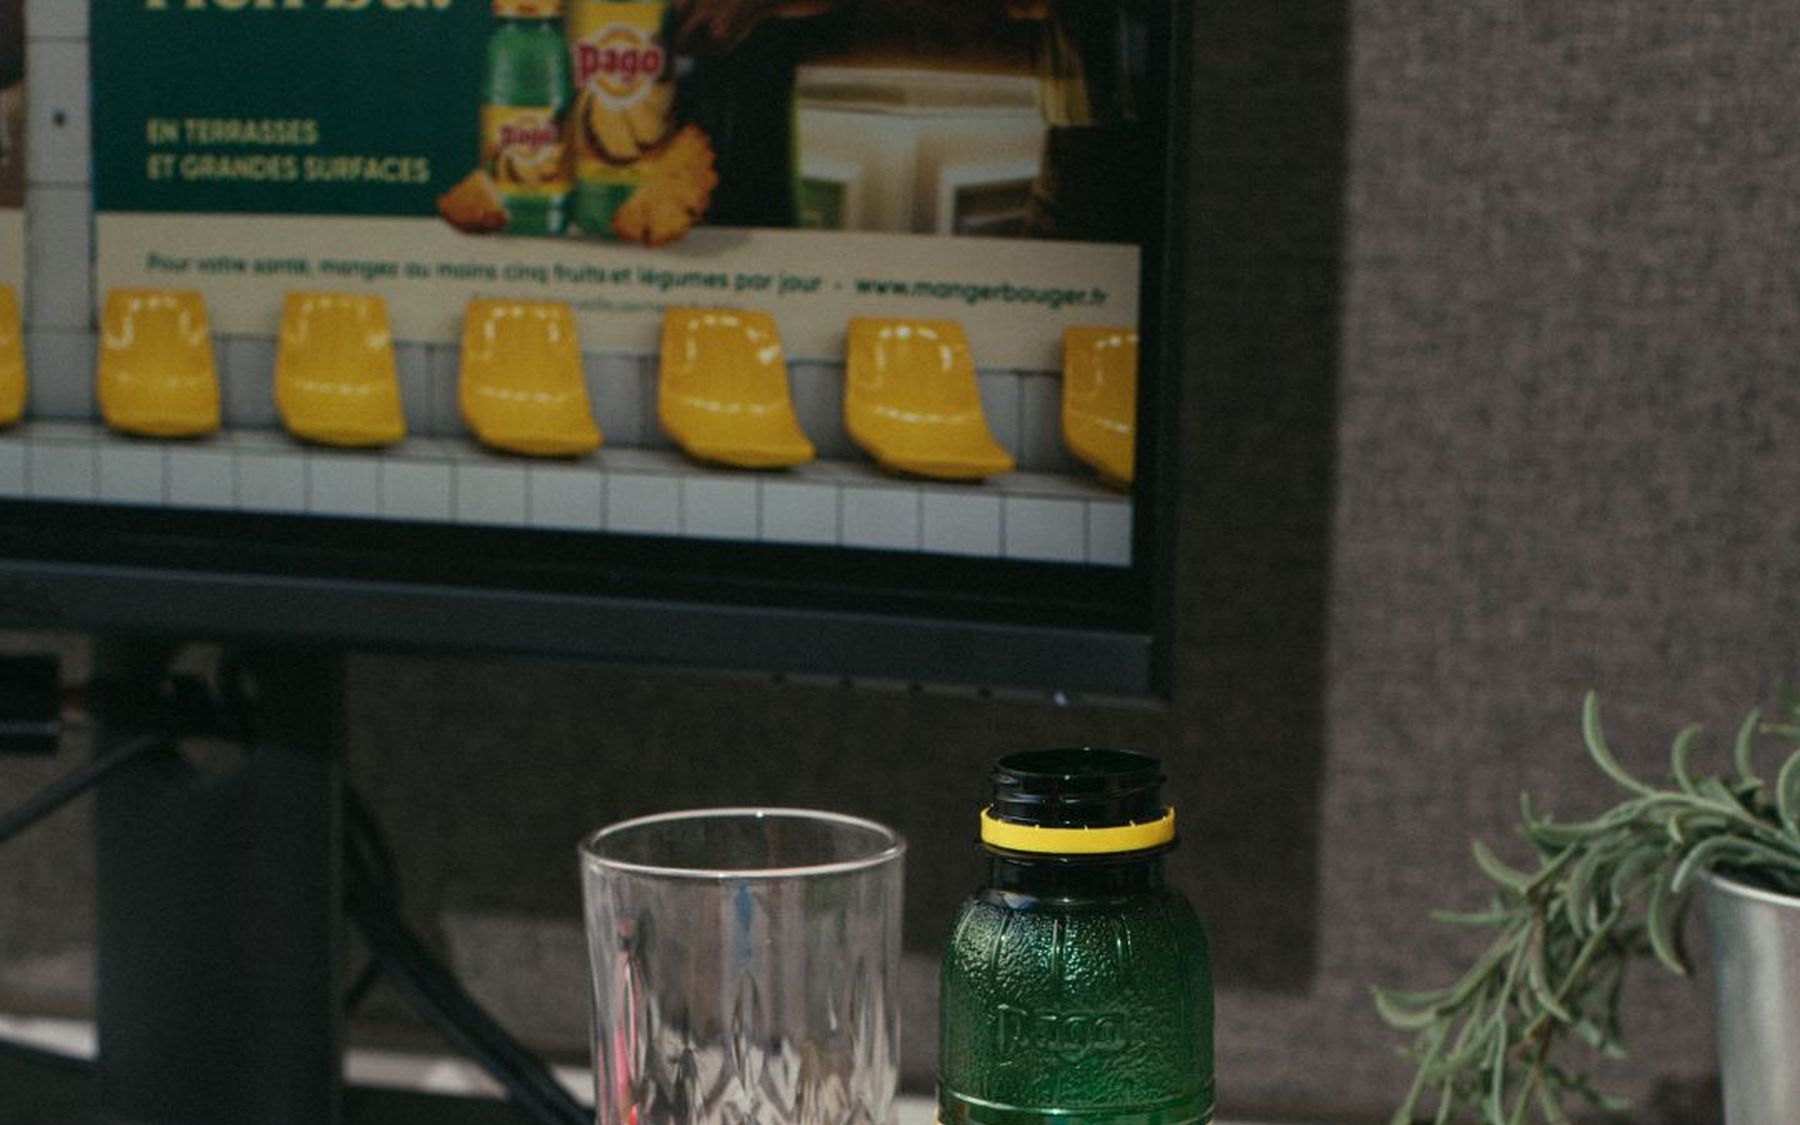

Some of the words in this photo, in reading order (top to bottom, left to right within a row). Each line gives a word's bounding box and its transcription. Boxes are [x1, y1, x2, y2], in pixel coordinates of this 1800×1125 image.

[147, 118, 179, 145] EN
[184, 119, 318, 146] TERRASSES
[147, 155, 174, 181] ET
[180, 155, 298, 183] GRANDES
[303, 156, 430, 184] SURFACES
[146, 252, 194, 273] Pour
[199, 255, 246, 275] votre
[437, 262, 496, 282] moins
